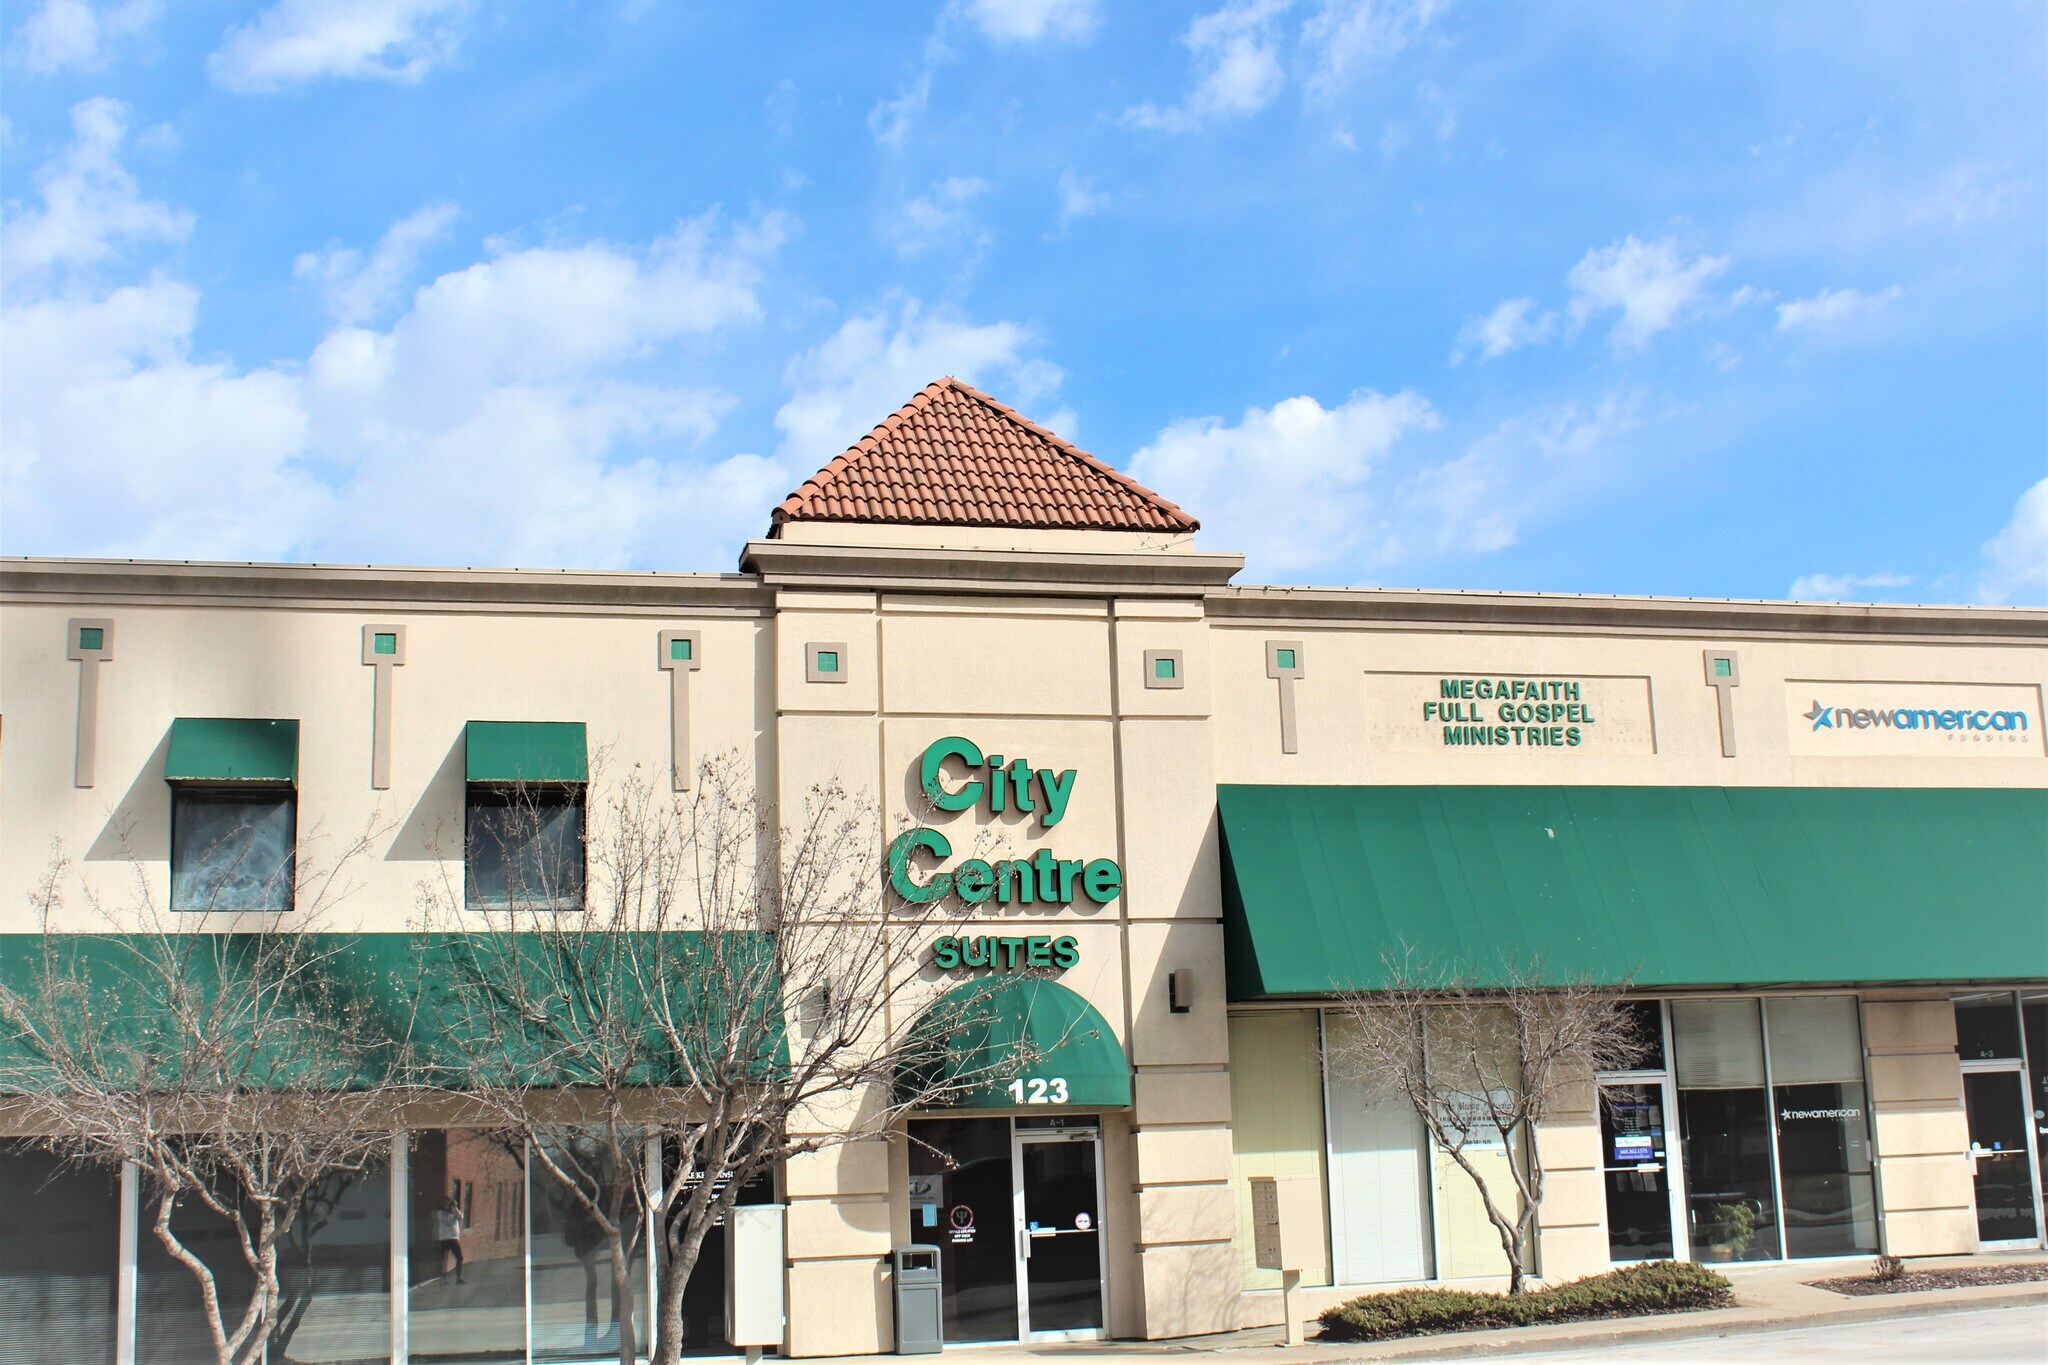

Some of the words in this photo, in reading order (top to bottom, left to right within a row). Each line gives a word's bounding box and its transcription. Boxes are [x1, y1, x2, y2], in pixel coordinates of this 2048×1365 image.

[1440, 679, 1580, 700] MEGAFAITH
[1424, 702, 1484, 721] FULL
[1499, 703, 1595, 723] GOSPEL
[1836, 707, 2028, 731] newamerican
[1443, 725, 1582, 746] MINISTRIES
[1947, 734, 2030, 743] FUNDING
[921, 736, 1078, 827] City
[888, 827, 1122, 904] Centre
[932, 935, 1080, 969] SUITES
[1980, 1050, 1994, 1058] A-3
[1008, 1077, 1069, 1104] 123
[1049, 1118, 1065, 1127] A-1
[1792, 1108, 1861, 1119] newamerican
